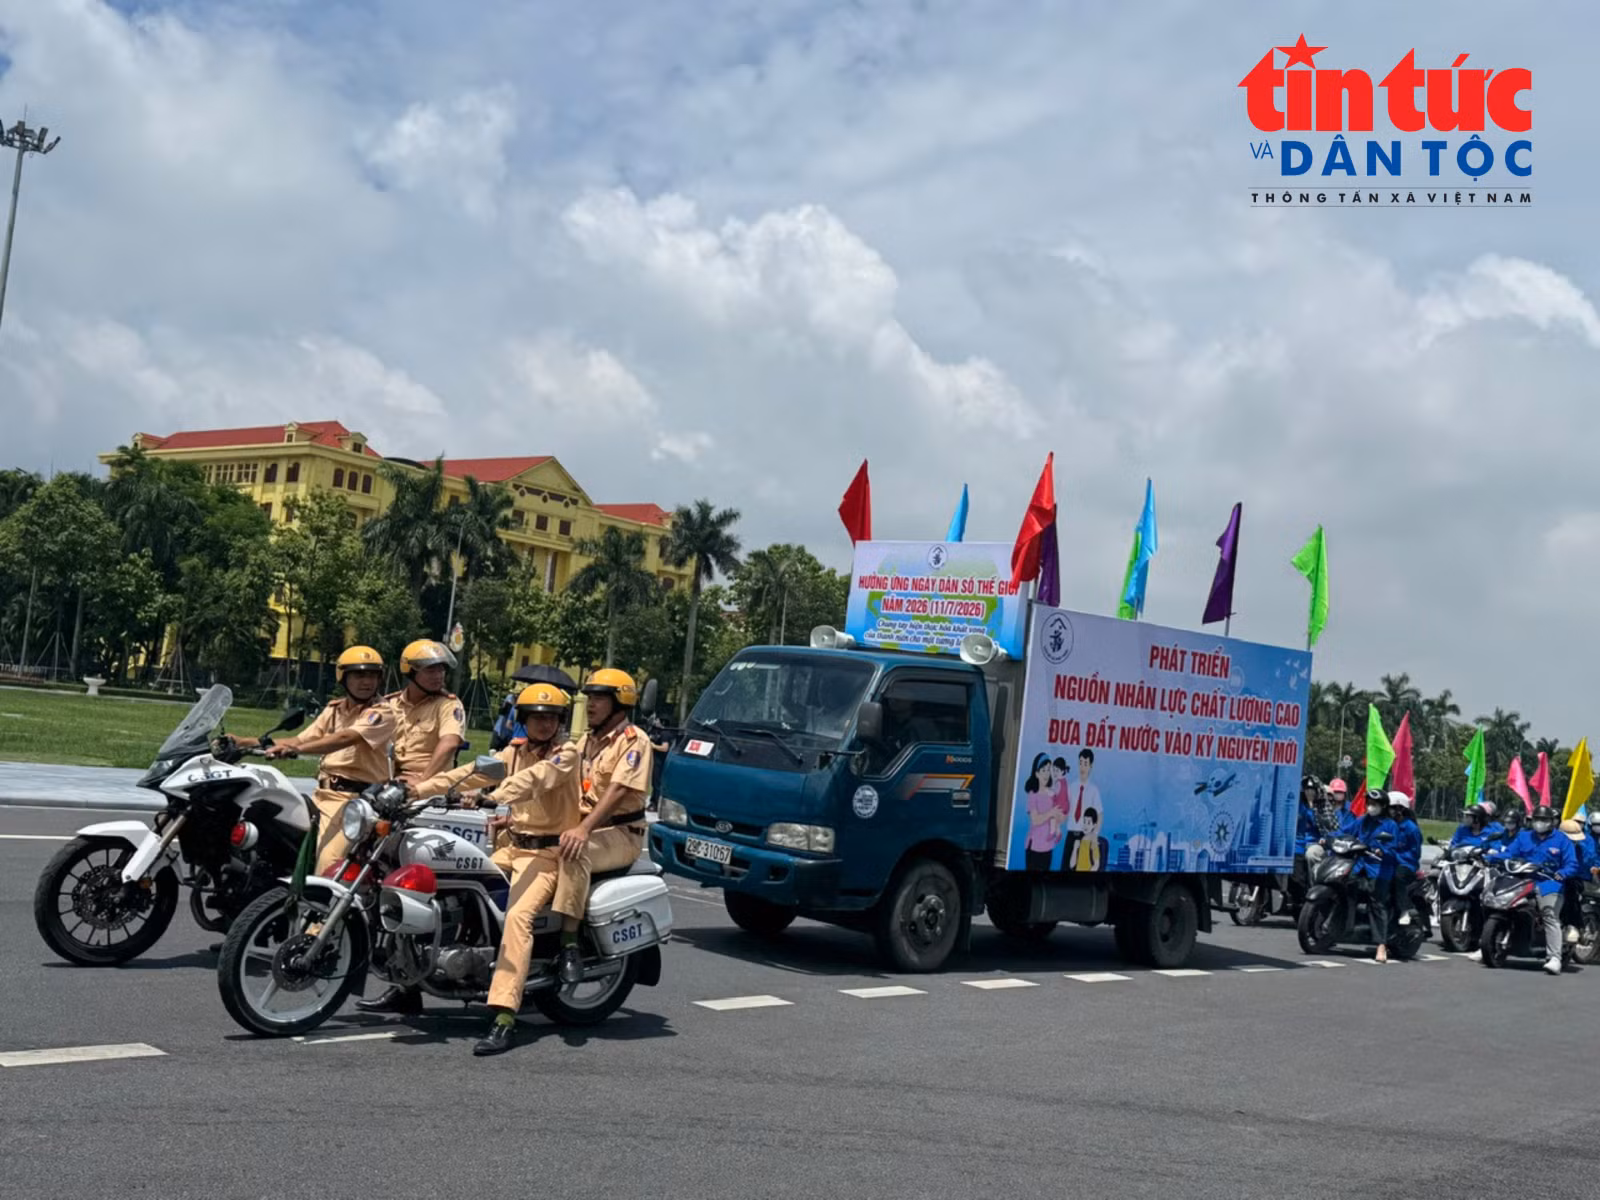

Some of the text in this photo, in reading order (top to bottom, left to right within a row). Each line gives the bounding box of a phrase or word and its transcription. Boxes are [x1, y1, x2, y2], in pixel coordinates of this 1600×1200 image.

[905, 599, 928, 614] 2026
[1149, 643, 1230, 679] PHÁT TRIỂN
[1054, 671, 1300, 727] NGUỒN NHÂN LỰC CHẤT LƯỢNG CAO
[1048, 715, 1297, 765] ĐƯA ĐẤT NƯỚC VÀO KỶ NGUYÊN MỚI
[441, 824, 484, 844] SGT
[456, 857, 484, 869] CSGT
[612, 923, 642, 944] CSGT
